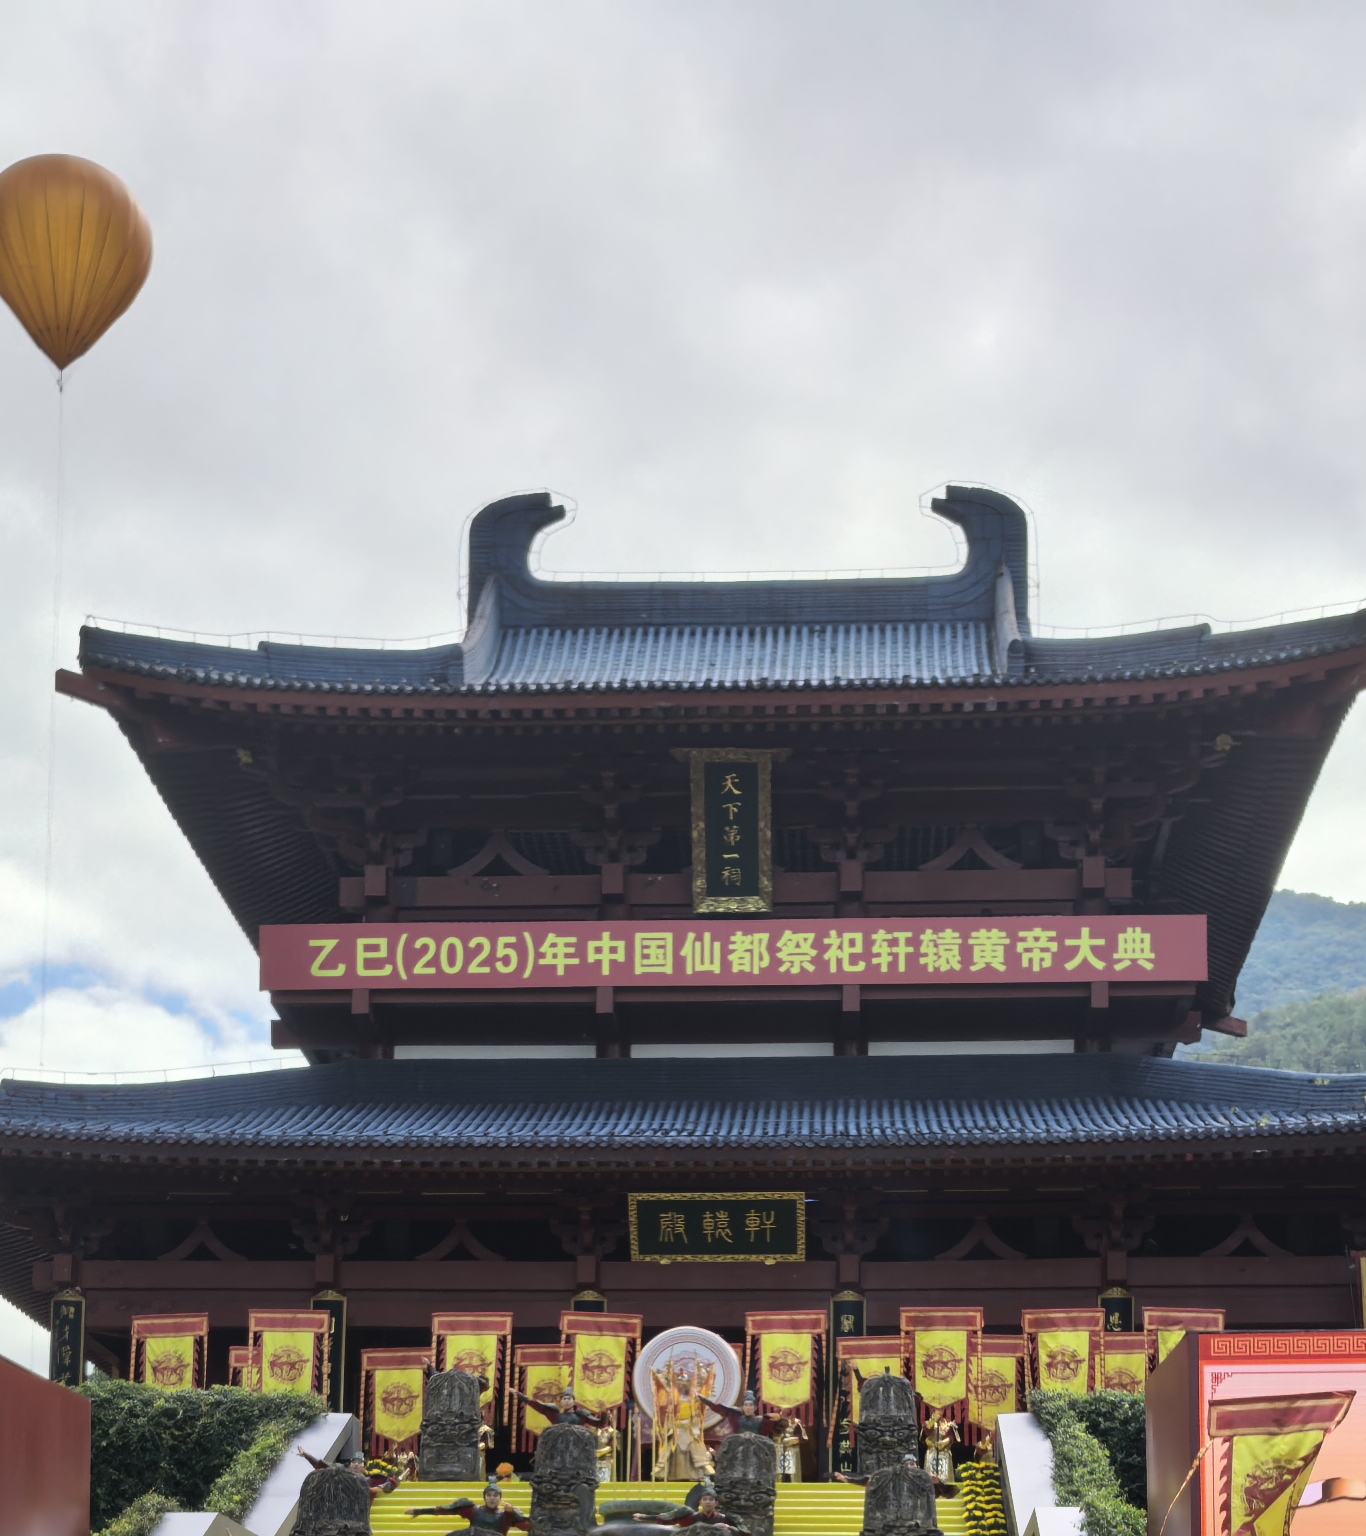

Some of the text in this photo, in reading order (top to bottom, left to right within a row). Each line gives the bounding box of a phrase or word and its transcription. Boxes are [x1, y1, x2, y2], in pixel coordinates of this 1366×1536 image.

[720, 773, 743, 887] 天下第一祠
[307, 926, 1156, 981] 乙巳(2025)年中国仙都祭祀轩辕黄帝大典
